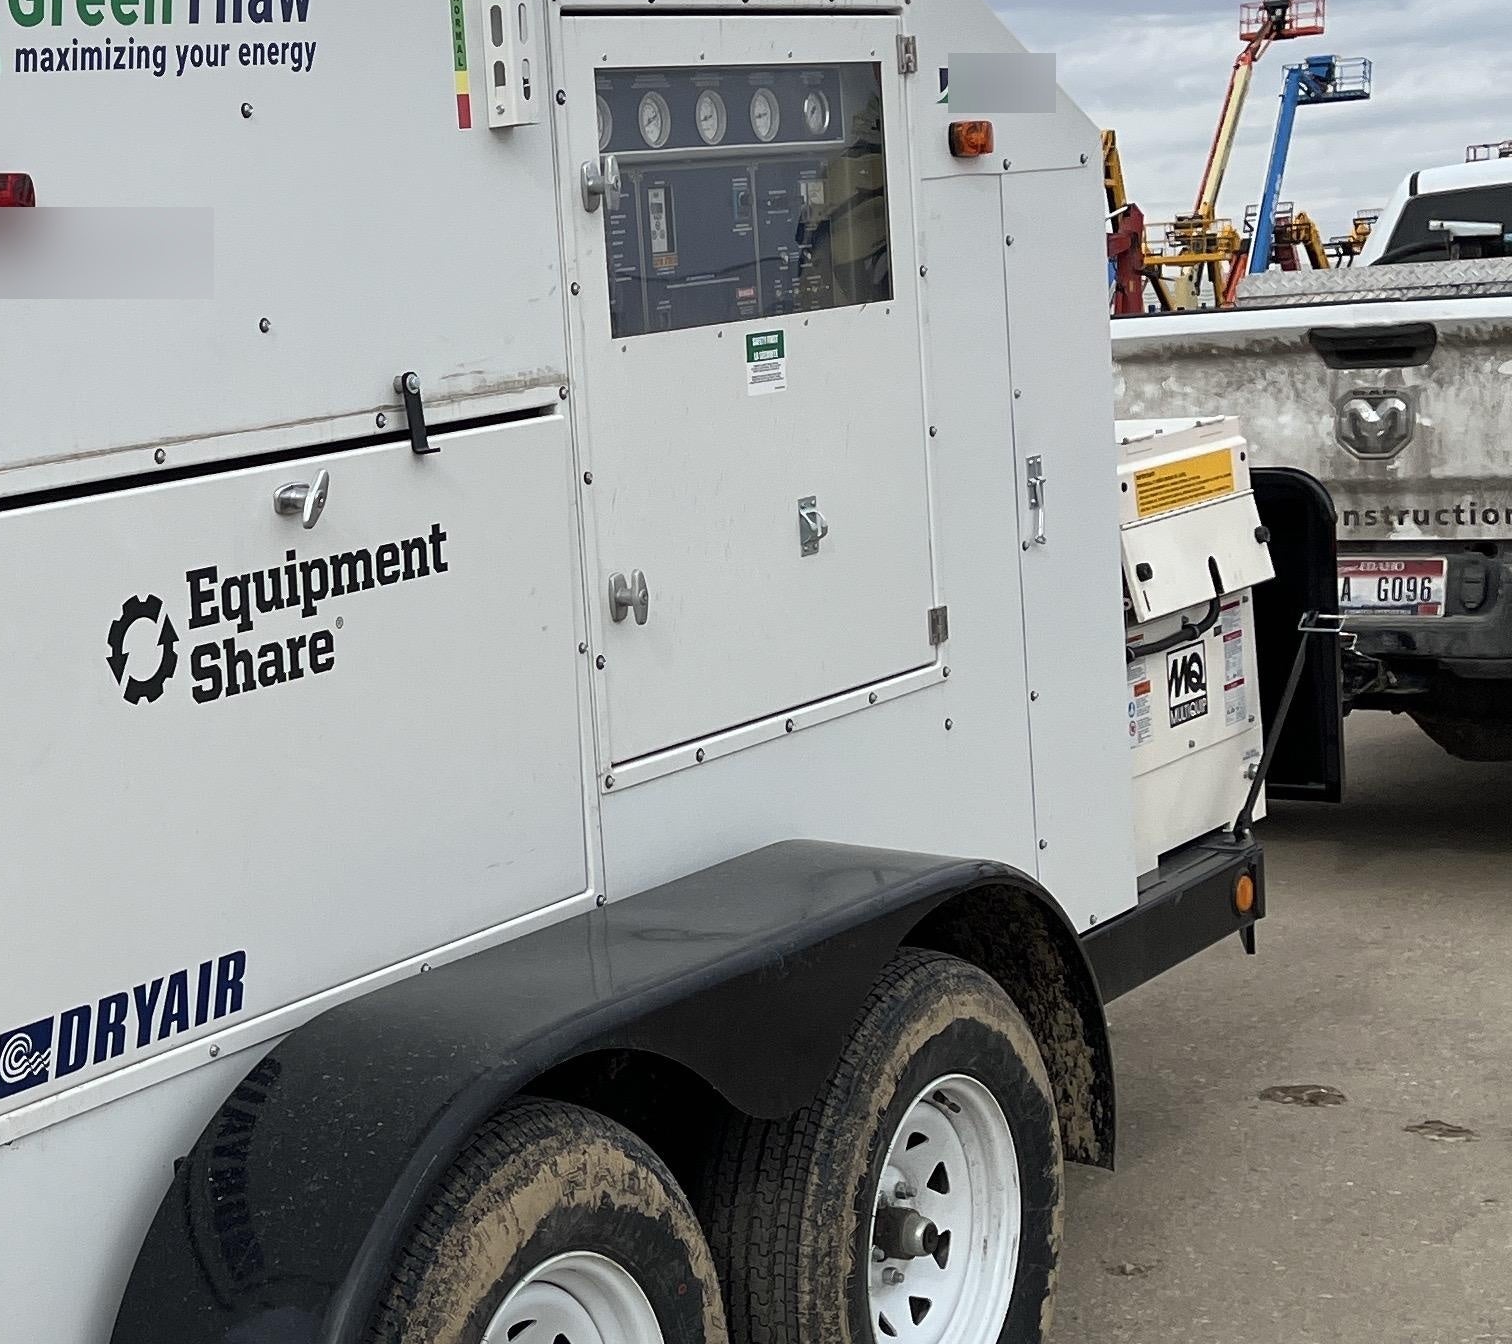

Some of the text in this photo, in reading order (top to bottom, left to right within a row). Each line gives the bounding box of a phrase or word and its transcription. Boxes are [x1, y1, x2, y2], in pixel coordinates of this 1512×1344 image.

[15, 37, 317, 77] maximizing your energy
[185, 523, 449, 634] Equipment
[190, 629, 335, 705] Share
[54, 949, 247, 1080] DRYAIR
